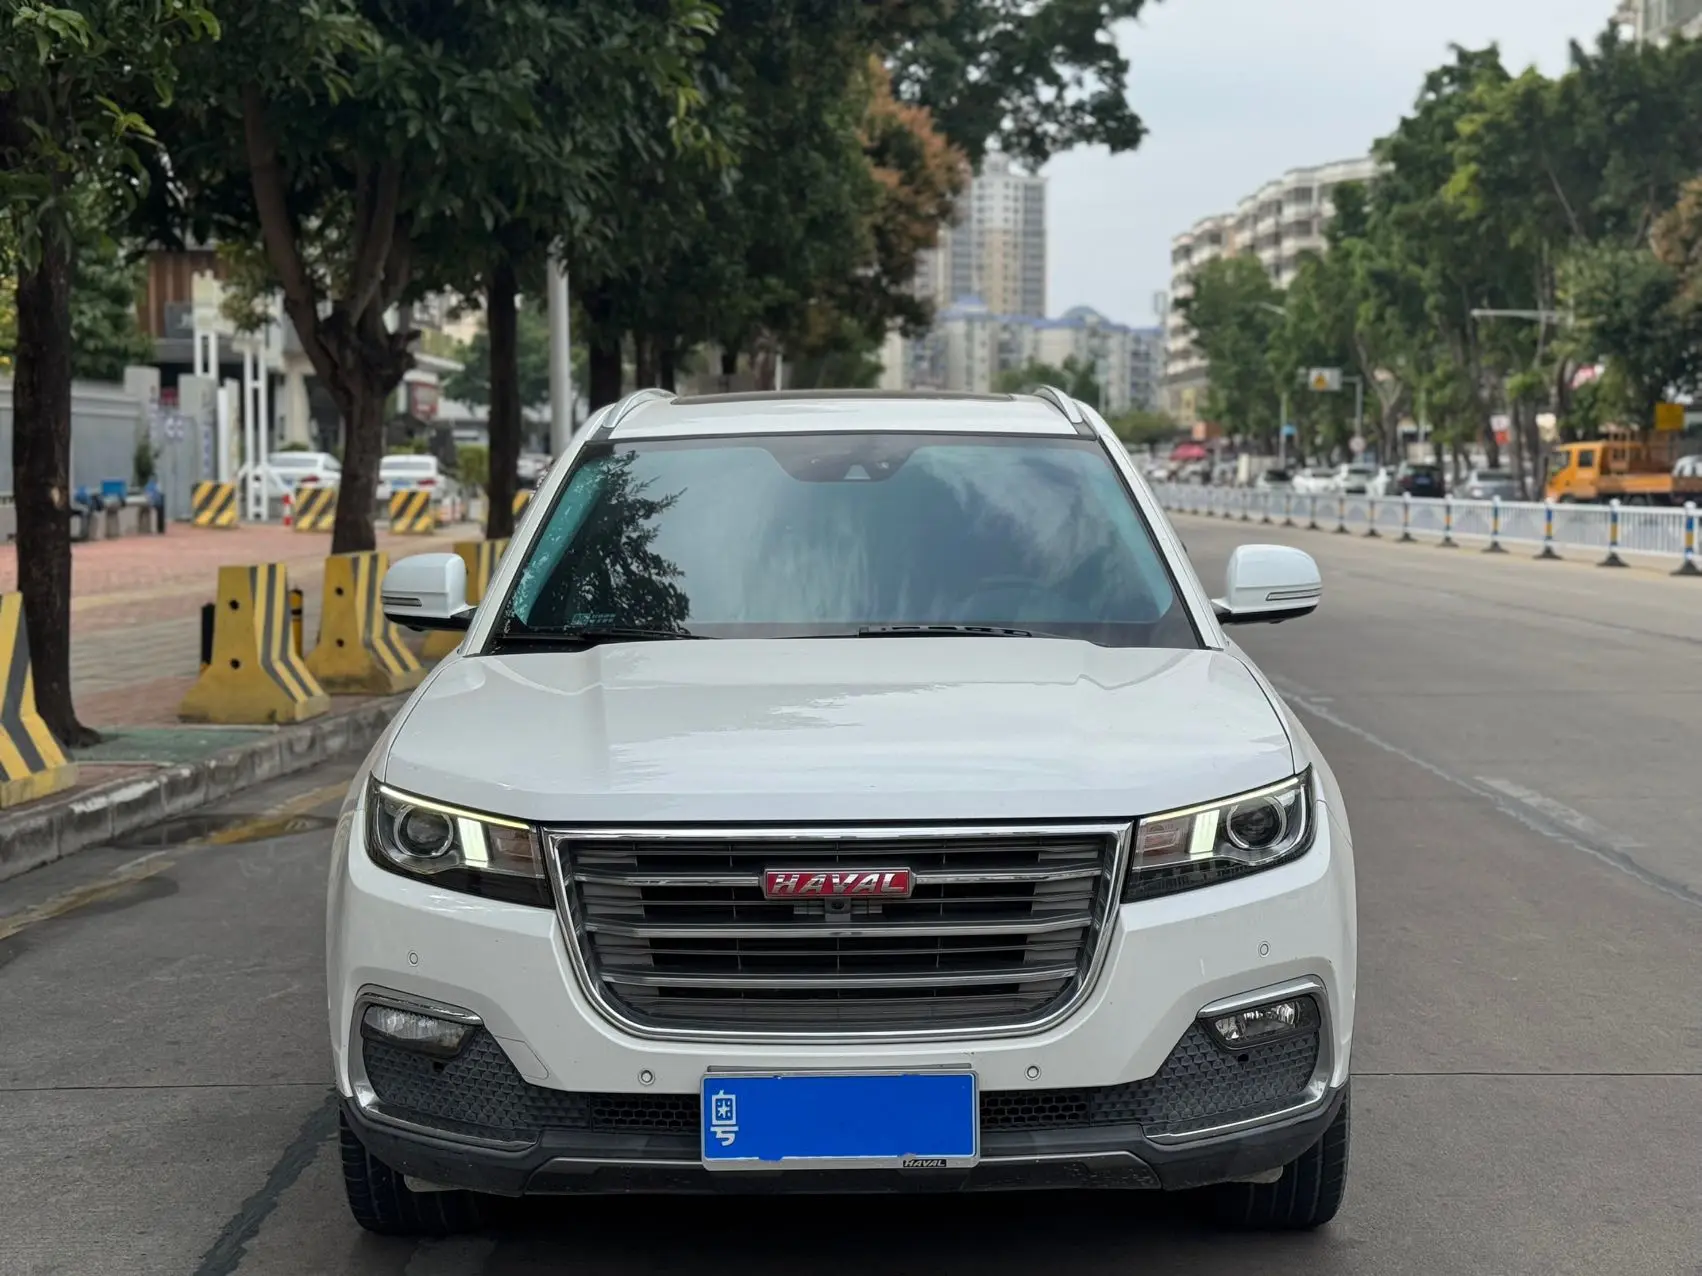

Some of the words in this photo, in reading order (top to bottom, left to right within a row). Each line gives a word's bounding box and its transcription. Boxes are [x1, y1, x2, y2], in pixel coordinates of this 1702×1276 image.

[772, 873, 905, 895] HAVAL
[710, 1089, 739, 1146] 粤
[904, 1159, 946, 1167] HAVAL
